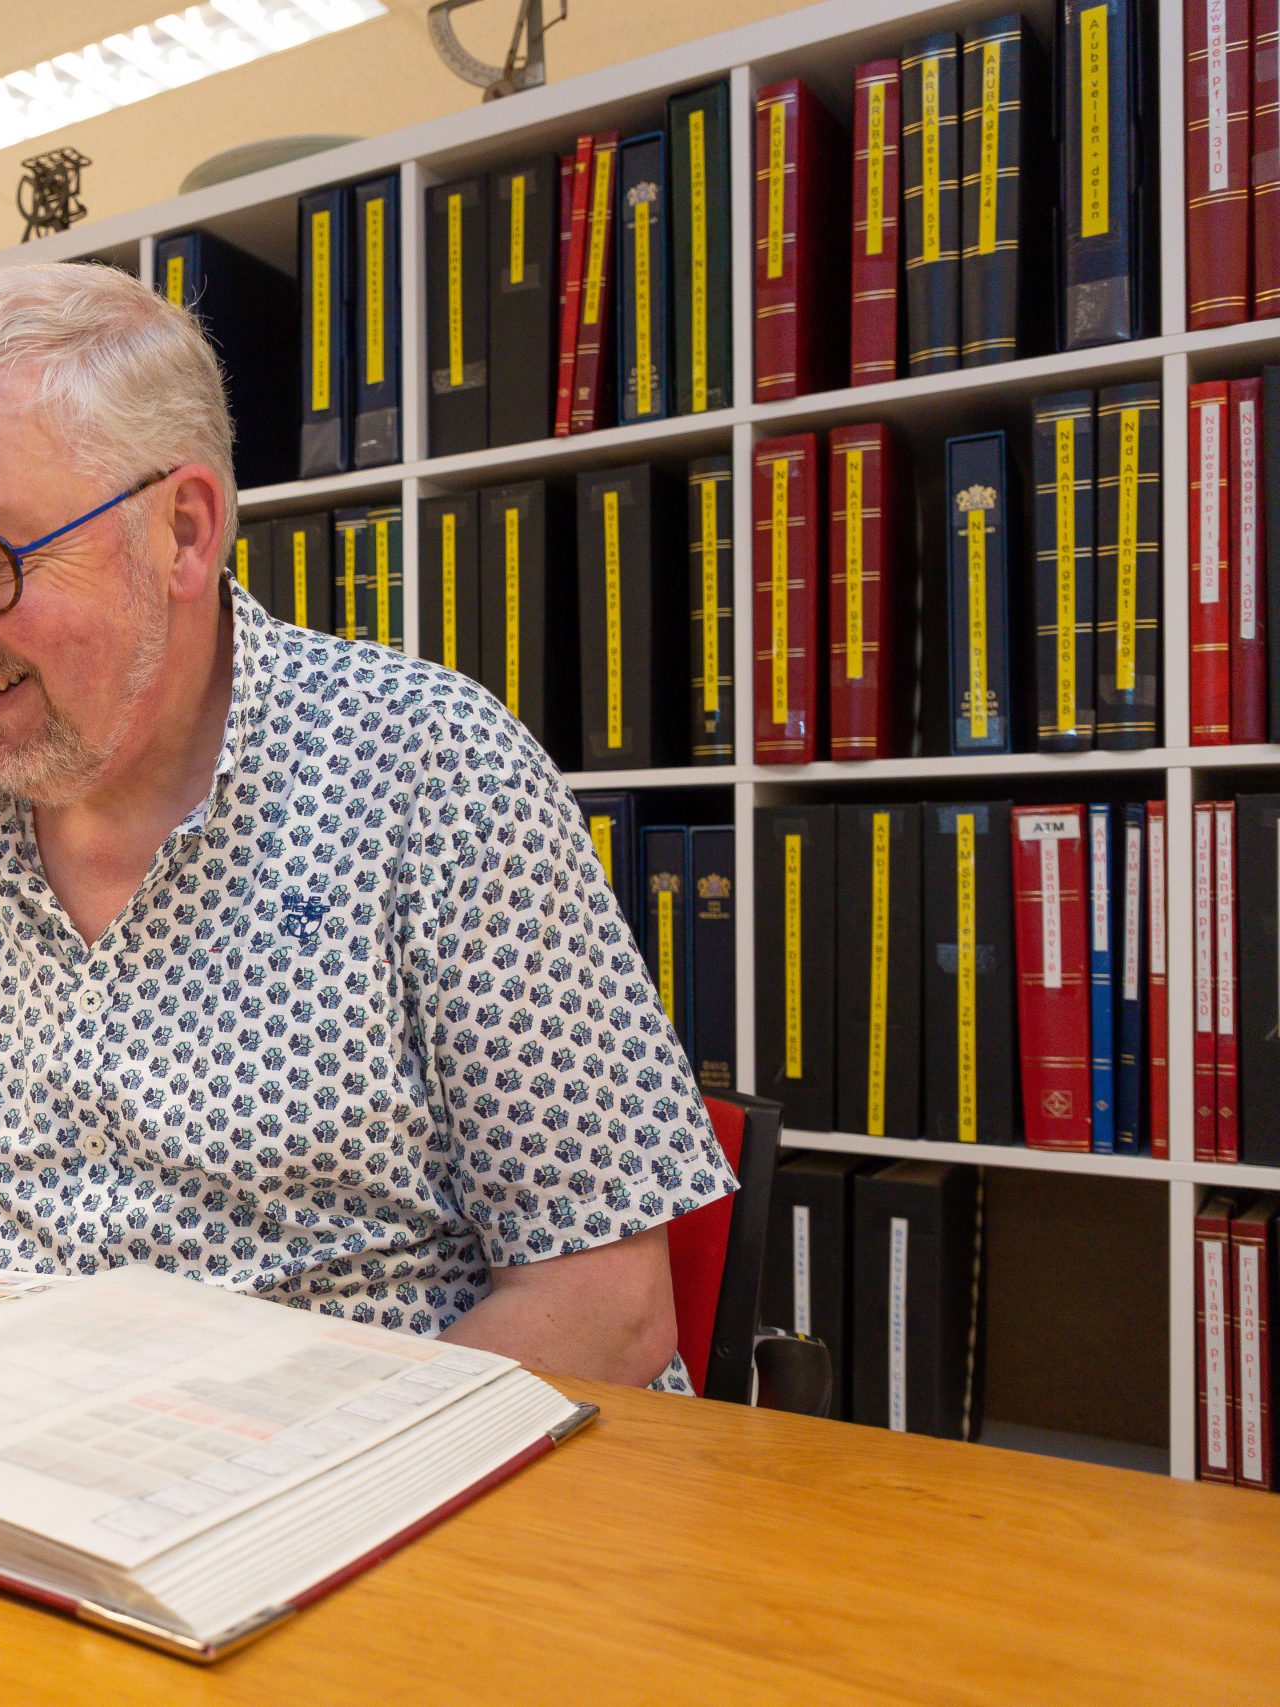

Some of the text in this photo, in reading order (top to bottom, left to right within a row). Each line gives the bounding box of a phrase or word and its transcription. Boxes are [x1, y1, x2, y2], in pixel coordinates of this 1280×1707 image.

[1089, 19, 1100, 74] Aruba
[925, 69, 936, 128] ARUBA
[984, 54, 997, 114] ARUBA
[1090, 78, 1100, 145] vellen
[1212, 75, 1221, 100] pf
[772, 114, 782, 170] ARUBA
[870, 93, 882, 151] ARUBA
[692, 121, 702, 199] Suriname
[1213, 135, 1222, 175] 310
[984, 172, 993, 209] 574
[1090, 165, 1100, 221] delen
[1059, 431, 1071, 466] Ned
[1124, 421, 1136, 457] Ned
[1204, 414, 1216, 499] Noorwegen
[1242, 412, 1254, 516] Noorwegen
[775, 469, 786, 504] Ned
[849, 461, 859, 485] NL
[704, 489, 716, 568] Suriname
[848, 489, 859, 576] Antillen
[971, 521, 982, 545] NL
[1060, 471, 1071, 564] Antillen
[1122, 463, 1134, 557] Antillen
[507, 517, 518, 590] Suriname
[606, 502, 618, 577] Suriname
[775, 508, 785, 593] Antillen
[972, 550, 983, 639] Antillen
[1204, 553, 1214, 589] 302
[1242, 583, 1253, 624] 302
[1061, 625, 1071, 664] 206
[1121, 619, 1131, 659] 959
[876, 823, 886, 854] ATM
[960, 825, 972, 861] ATM
[1033, 821, 1065, 833] ATM
[1094, 826, 1106, 865] ATM
[788, 845, 798, 874] ATM
[1198, 825, 1208, 911] IJsland
[1219, 822, 1228, 906] IJsland
[788, 878, 797, 939] Andorra
[875, 856, 885, 941] Duitsland
[1127, 840, 1139, 986] ATM Zwitserland
[660, 899, 670, 977] Suriname
[788, 949, 798, 1032] Duitsland
[1199, 976, 1210, 1017] 230
[1221, 978, 1230, 1019] 230
[961, 1005, 972, 1128] Zwitserland
[1207, 1252, 1220, 1337] Finland
[1243, 1257, 1254, 1343] Finland
[1212, 1414, 1222, 1453] 285
[1246, 1420, 1257, 1459] 285
